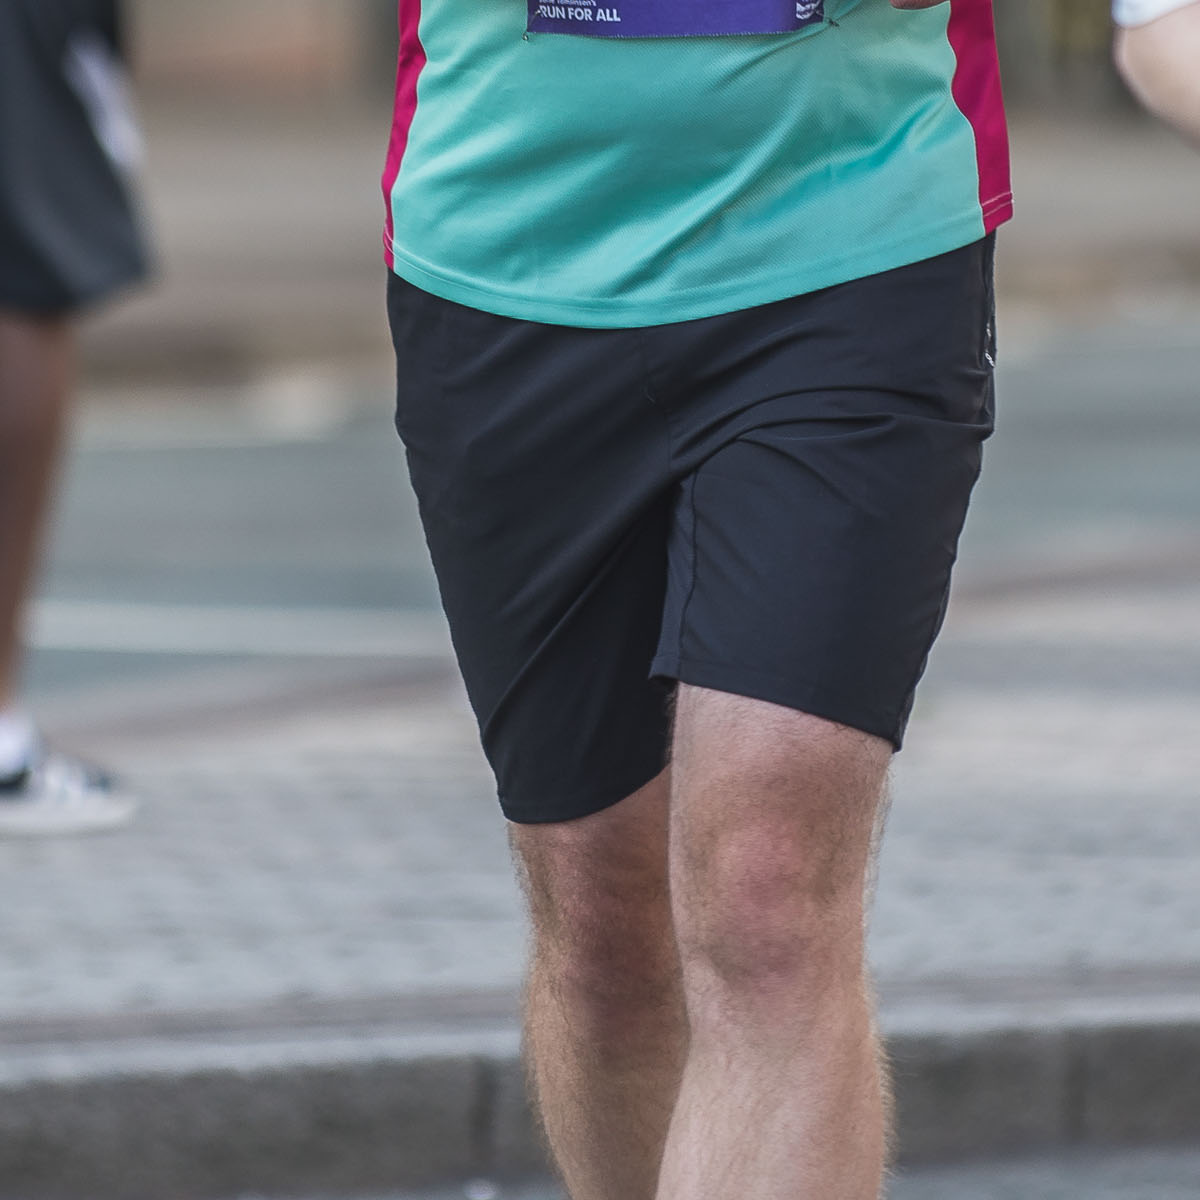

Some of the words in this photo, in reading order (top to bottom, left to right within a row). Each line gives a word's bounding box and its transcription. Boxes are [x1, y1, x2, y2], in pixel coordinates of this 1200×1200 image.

[539, 5, 566, 19] RUN
[567, 7, 593, 22] FOR
[596, 8, 621, 22] ALL
